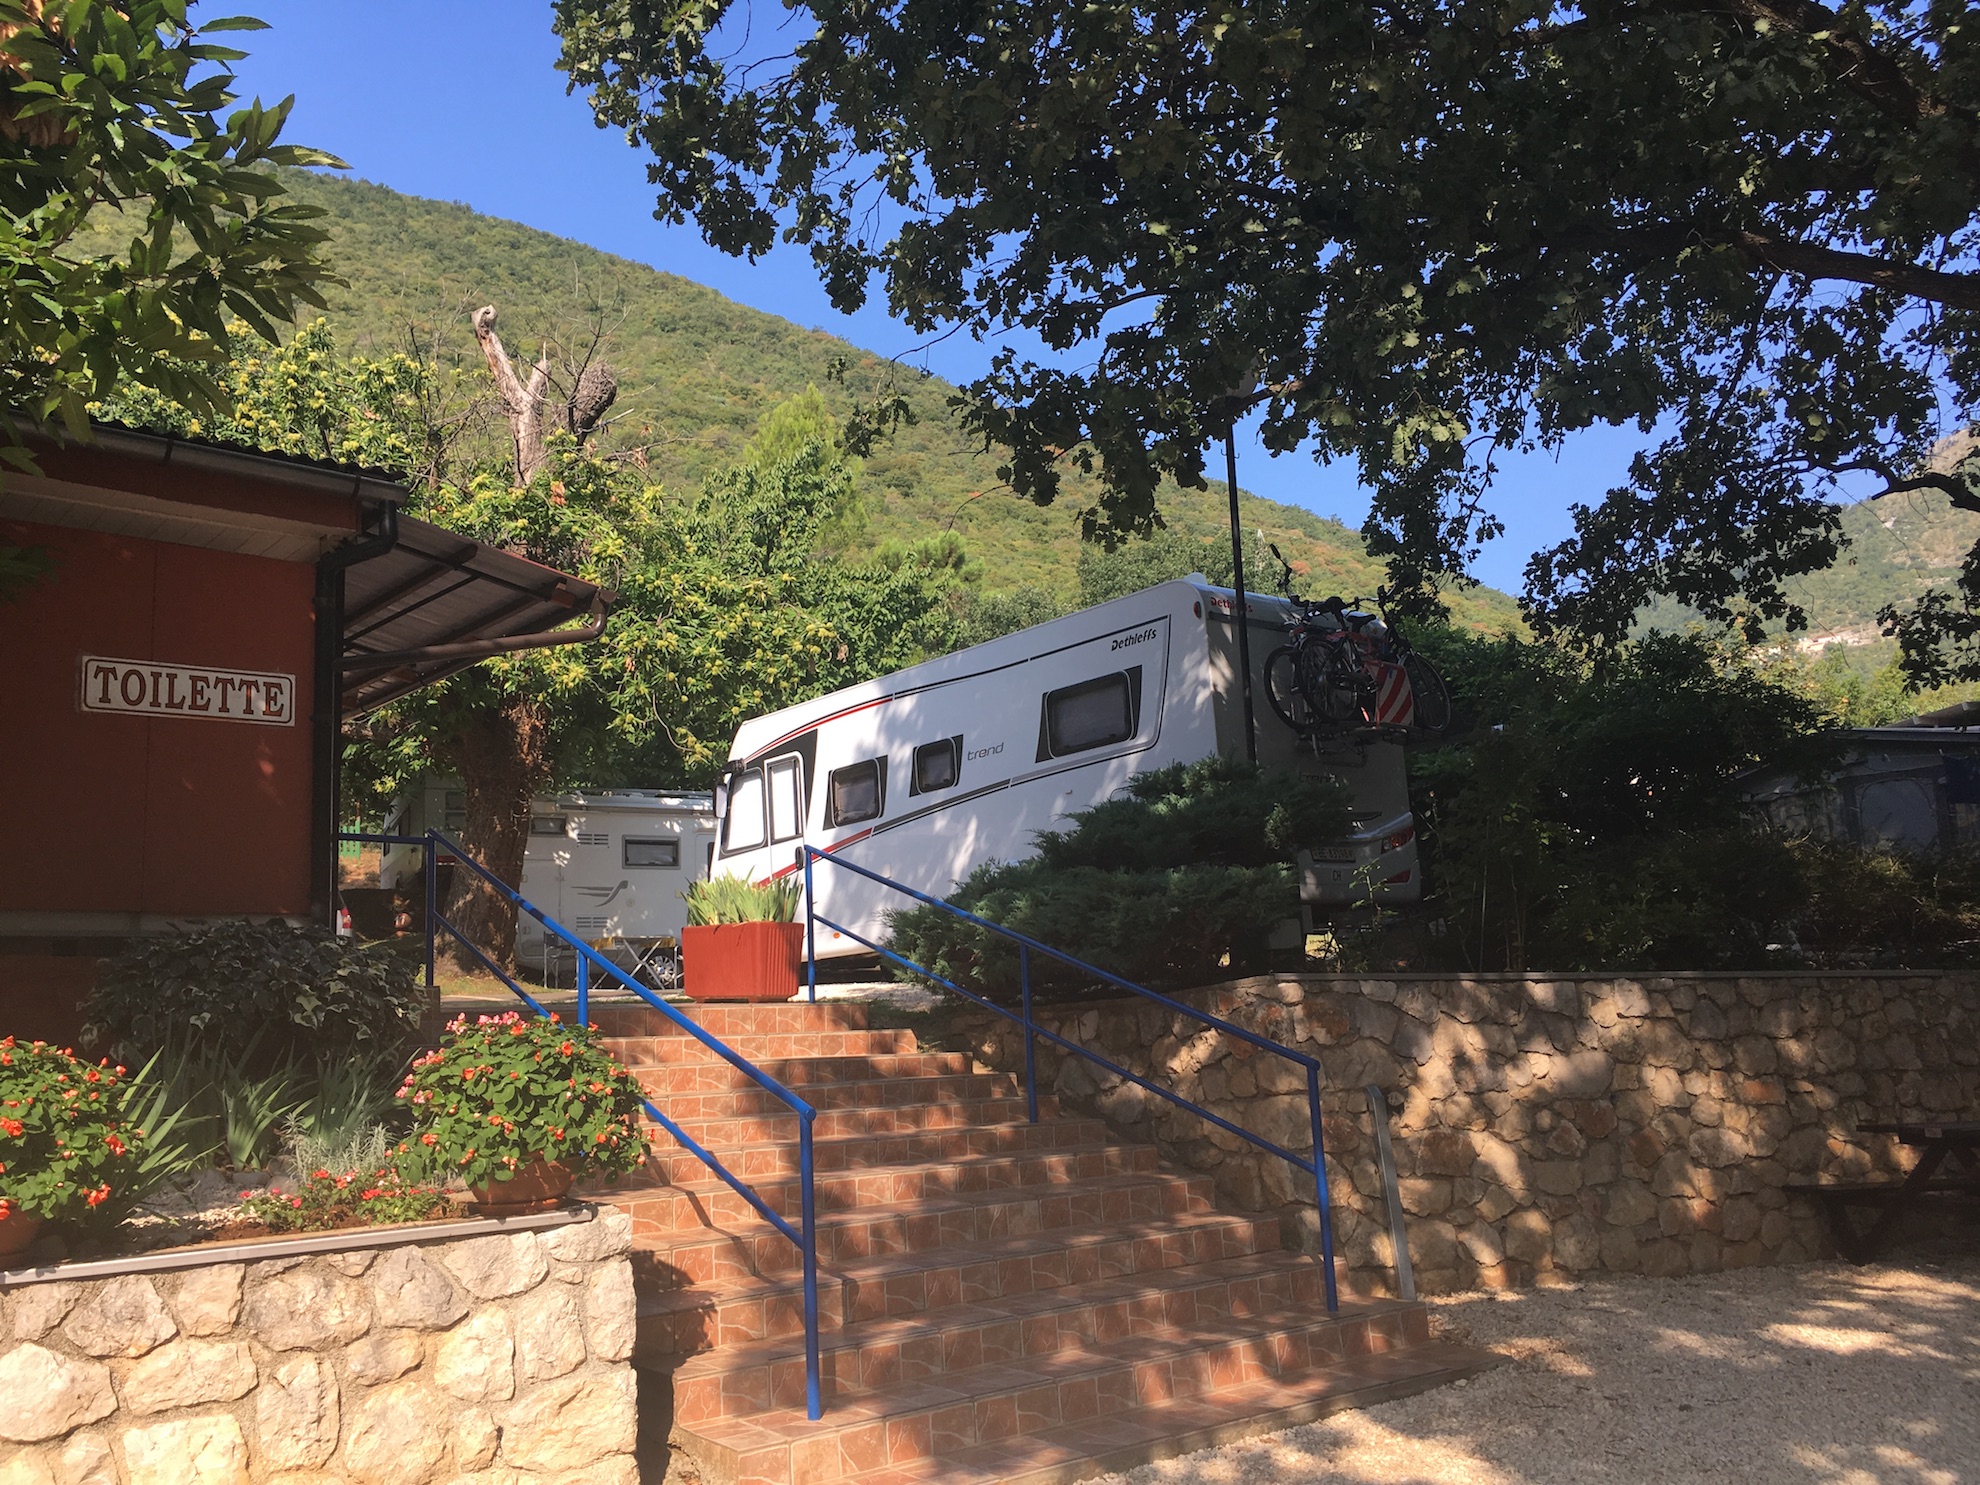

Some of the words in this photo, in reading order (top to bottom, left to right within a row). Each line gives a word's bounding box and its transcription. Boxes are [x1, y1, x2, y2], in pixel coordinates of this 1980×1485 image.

[1111, 628, 1157, 651] Dethleffs
[93, 665, 284, 717] TOILETTE
[967, 742, 1004, 761] trend
[1332, 869, 1342, 881] CH
